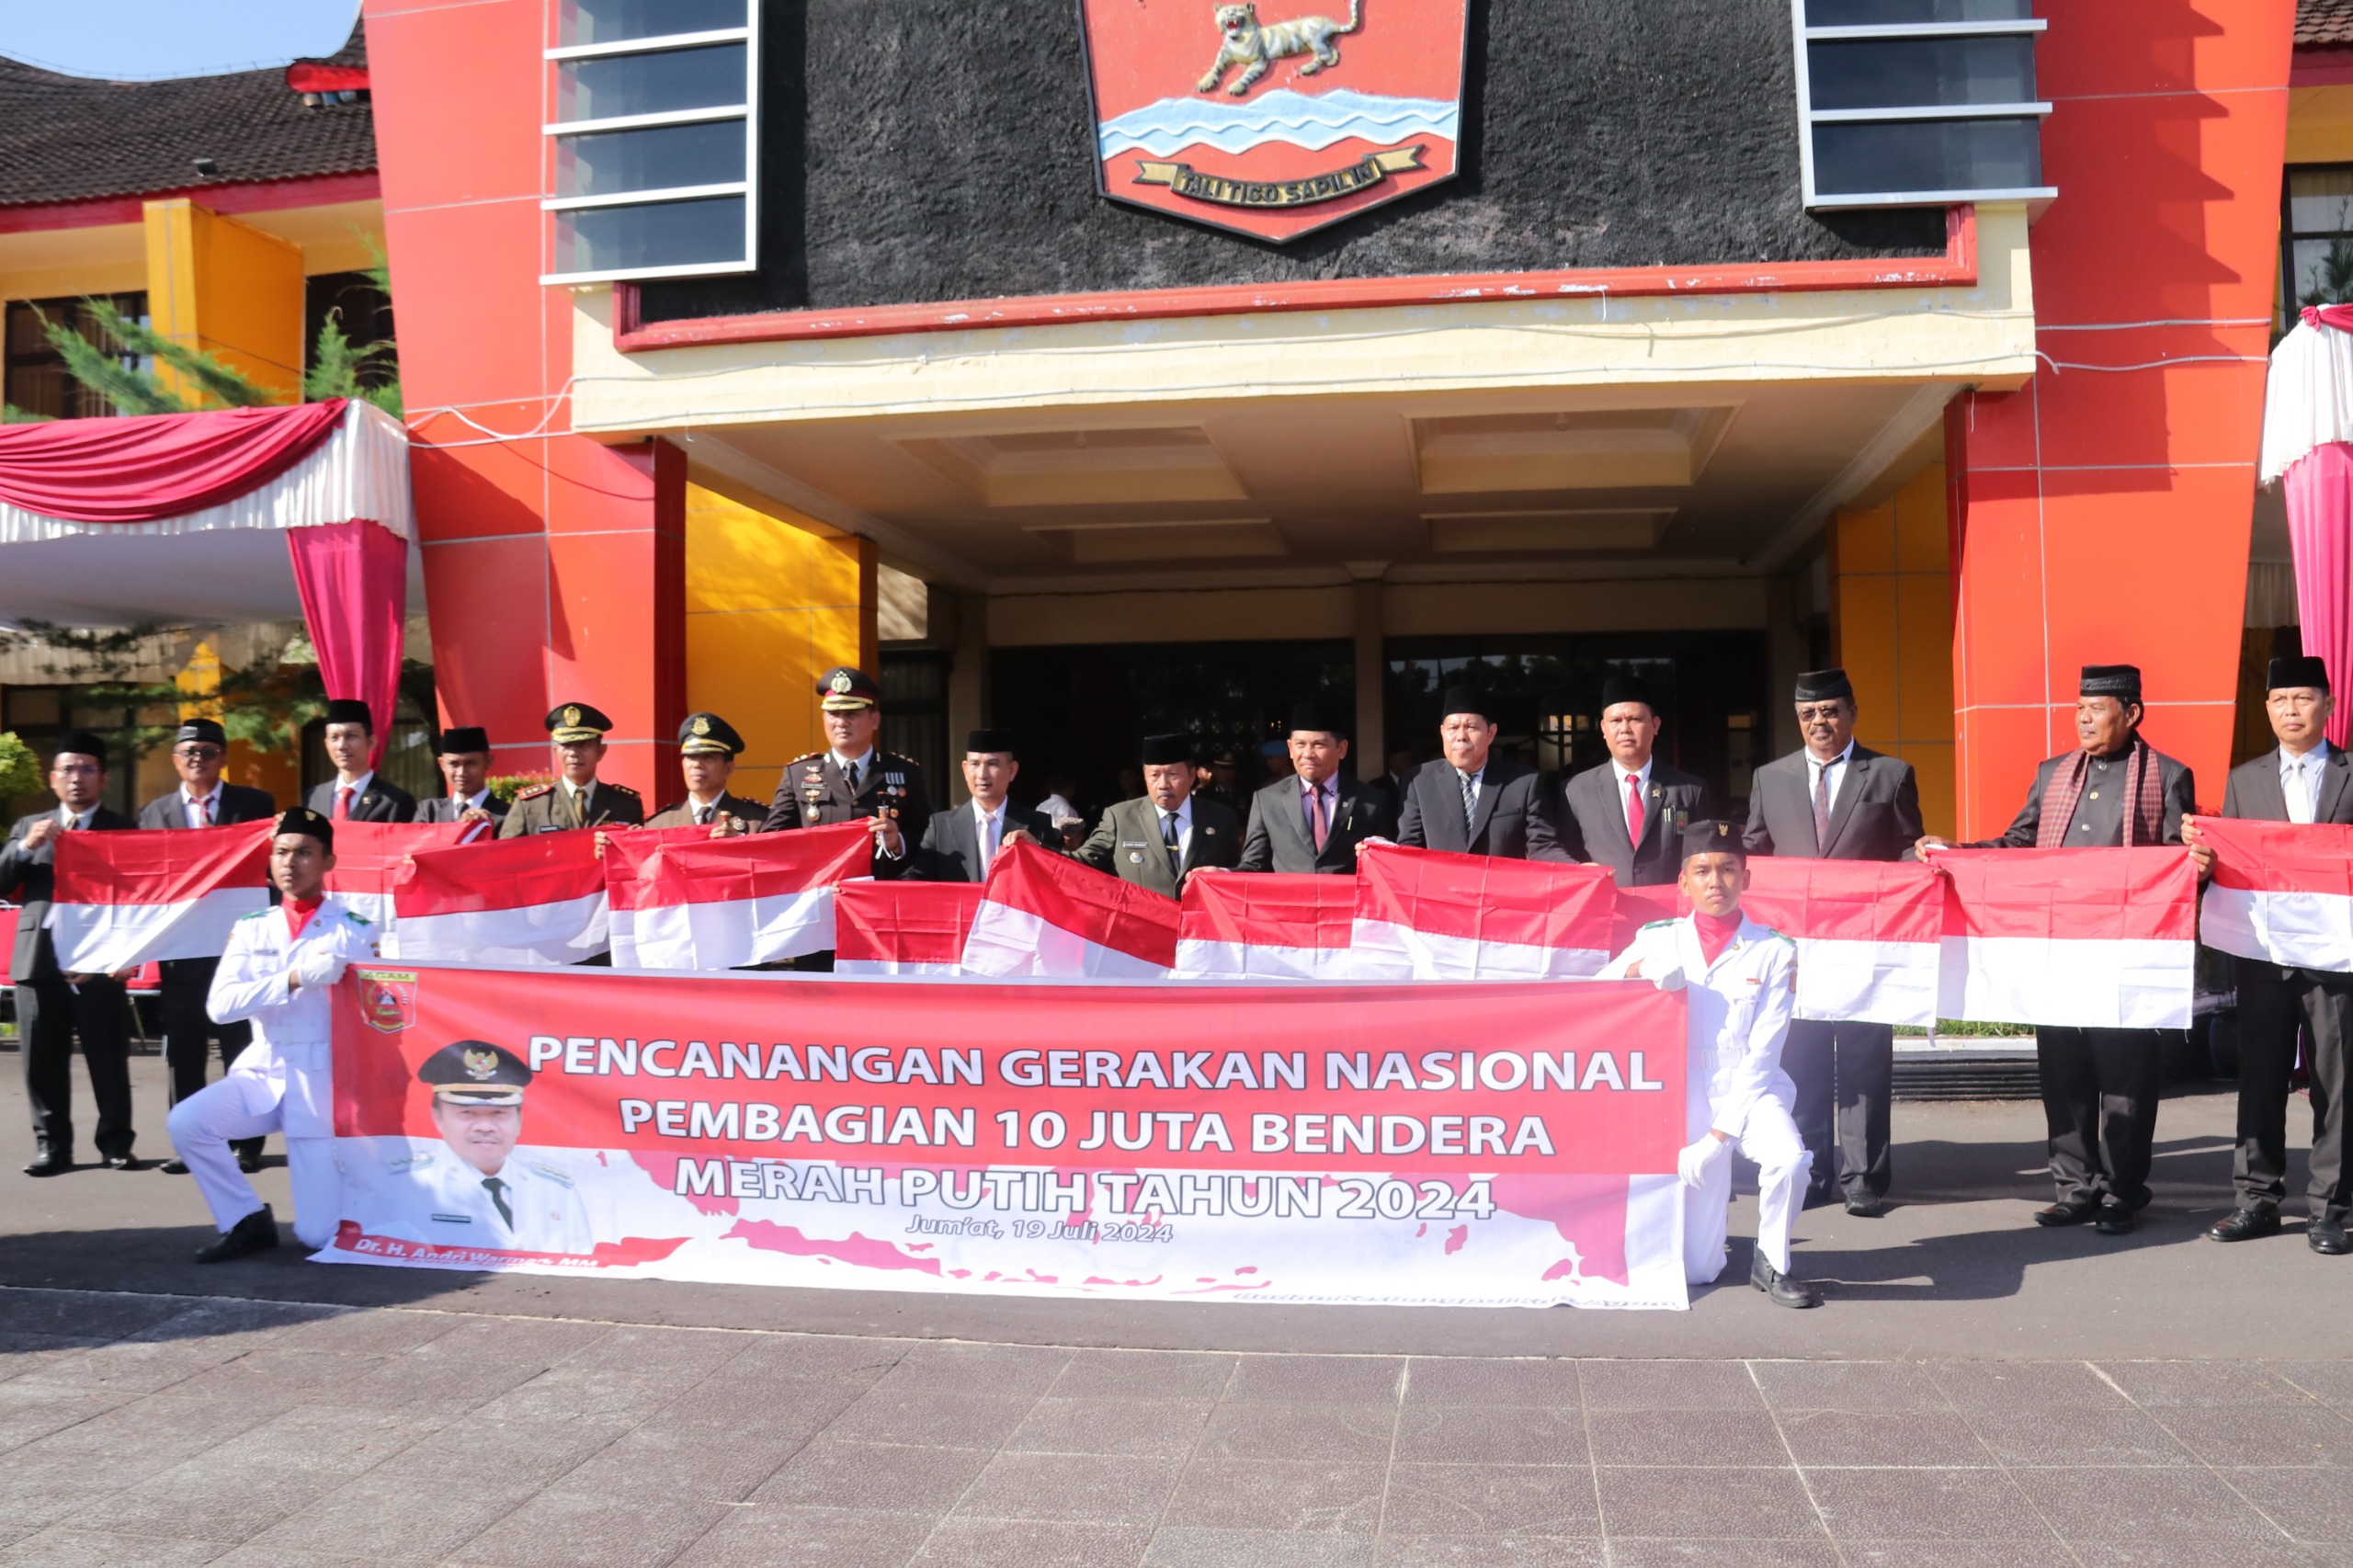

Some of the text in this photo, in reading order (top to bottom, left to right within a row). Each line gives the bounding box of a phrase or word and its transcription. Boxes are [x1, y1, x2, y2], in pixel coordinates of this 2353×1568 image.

[1181, 173, 1222, 199] TALI
[529, 1035, 1664, 1092] PENCANANGAN GERAKAN NASIONAL
[619, 1098, 1556, 1156] PEMBAGIAN 10 JUTA BENDERA
[674, 1157, 1496, 1221] MERAH PUTIH TAHUN 2024
[905, 1214, 1173, 1242] Jum'at, 19 Juli 2024
[355, 1239, 383, 1254] Dr.
[386, 1244, 407, 1257] H.
[413, 1247, 466, 1262] Andri
[558, 1256, 599, 1268] MM
